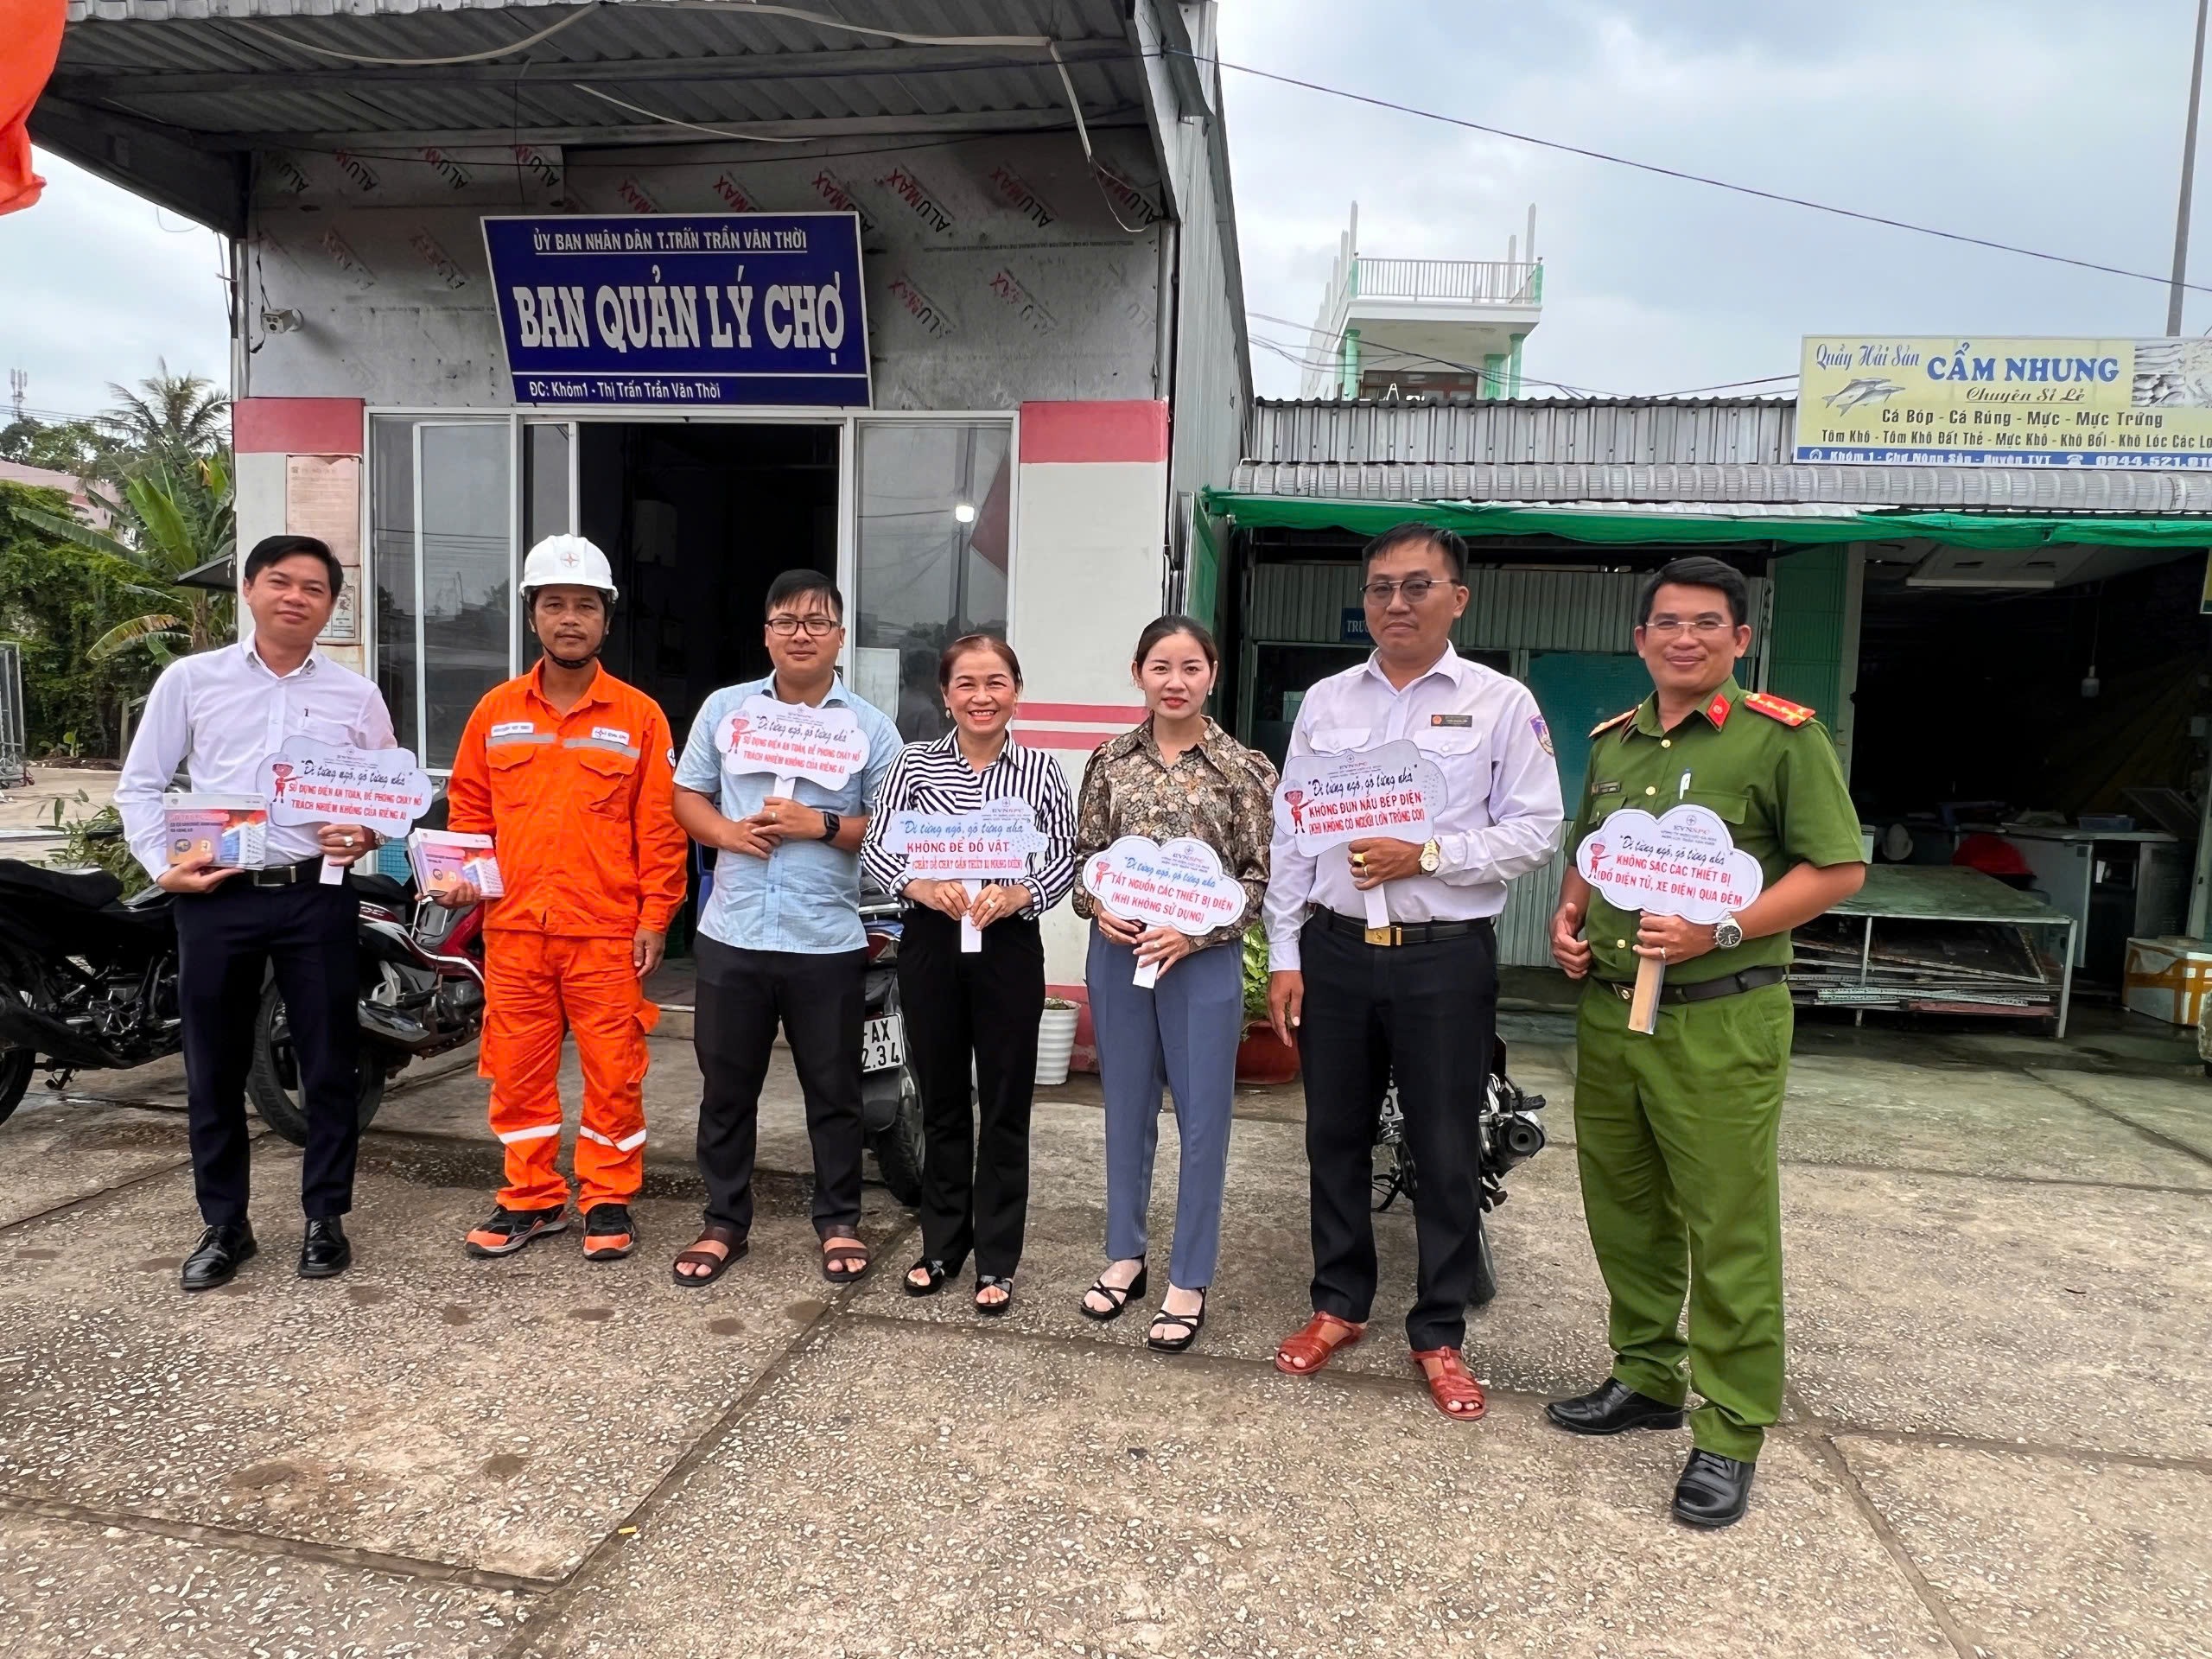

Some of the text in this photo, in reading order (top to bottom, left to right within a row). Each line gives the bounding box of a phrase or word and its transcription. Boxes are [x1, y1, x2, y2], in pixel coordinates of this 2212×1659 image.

[533, 228, 550, 251] ỦY
[556, 233, 582, 251] BAN
[586, 229, 621, 251] NHÂN
[625, 229, 652, 250] DÂN
[703, 225, 741, 249] TRẦN
[744, 229, 772, 249] VĂN
[774, 226, 807, 249] THỜI
[512, 264, 845, 365] BAN QUẢN LÝ CHỢ
[1858, 341, 2120, 382] Hải Sản CẨM NHUNG
[529, 381, 550, 397] ĐC:
[597, 382, 616, 401] Thị
[617, 379, 643, 398] Trấn
[645, 379, 670, 398] Trần
[671, 382, 694, 398] Văn
[695, 382, 721, 398] Thời
[1966, 386, 2031, 404] Chuyên
[1882, 409, 1899, 423] Cá
[1906, 410, 1934, 425] Bóp
[1949, 410, 1967, 424] Cá
[2027, 411, 2060, 429] Mực
[2075, 411, 2109, 429] Mực
[2116, 411, 2163, 428] Trứng
[1821, 429, 1846, 442] Tôm
[1849, 430, 1871, 443] Khô
[1884, 430, 1907, 444] Tôm
[1910, 430, 1932, 444] Khô
[1995, 432, 2021, 448] Mực
[2060, 434, 2082, 447] Khô
[2172, 435, 2195, 448] Các
[2200, 435, 2212, 448] Lo
[2027, 455, 2051, 465] TVT
[1308, 789, 1422, 818] KHÔNG ĐUN NẤU BẾP ĐIỆN
[907, 840, 945, 853] KHÔNG
[988, 839, 1009, 855] VẬT
[1616, 854, 1647, 869] KHÔNG
[1649, 861, 1668, 874] SẠC
[1691, 867, 1719, 882] THIẾT
[1720, 873, 1732, 887] BỊ
[1157, 881, 1174, 897] CÁC
[1176, 888, 1200, 904] THIẾT
[1201, 895, 1211, 908] BỊ
[1212, 897, 1233, 911] ĐIỆN
[1615, 873, 1637, 887] ĐIỆN
[1656, 880, 1669, 892] XE
[1699, 888, 1718, 902] QUA
[1720, 890, 1743, 906] ĐÊM
[1131, 896, 1162, 912] KHÔNG
[1163, 901, 1176, 915] SỬ
